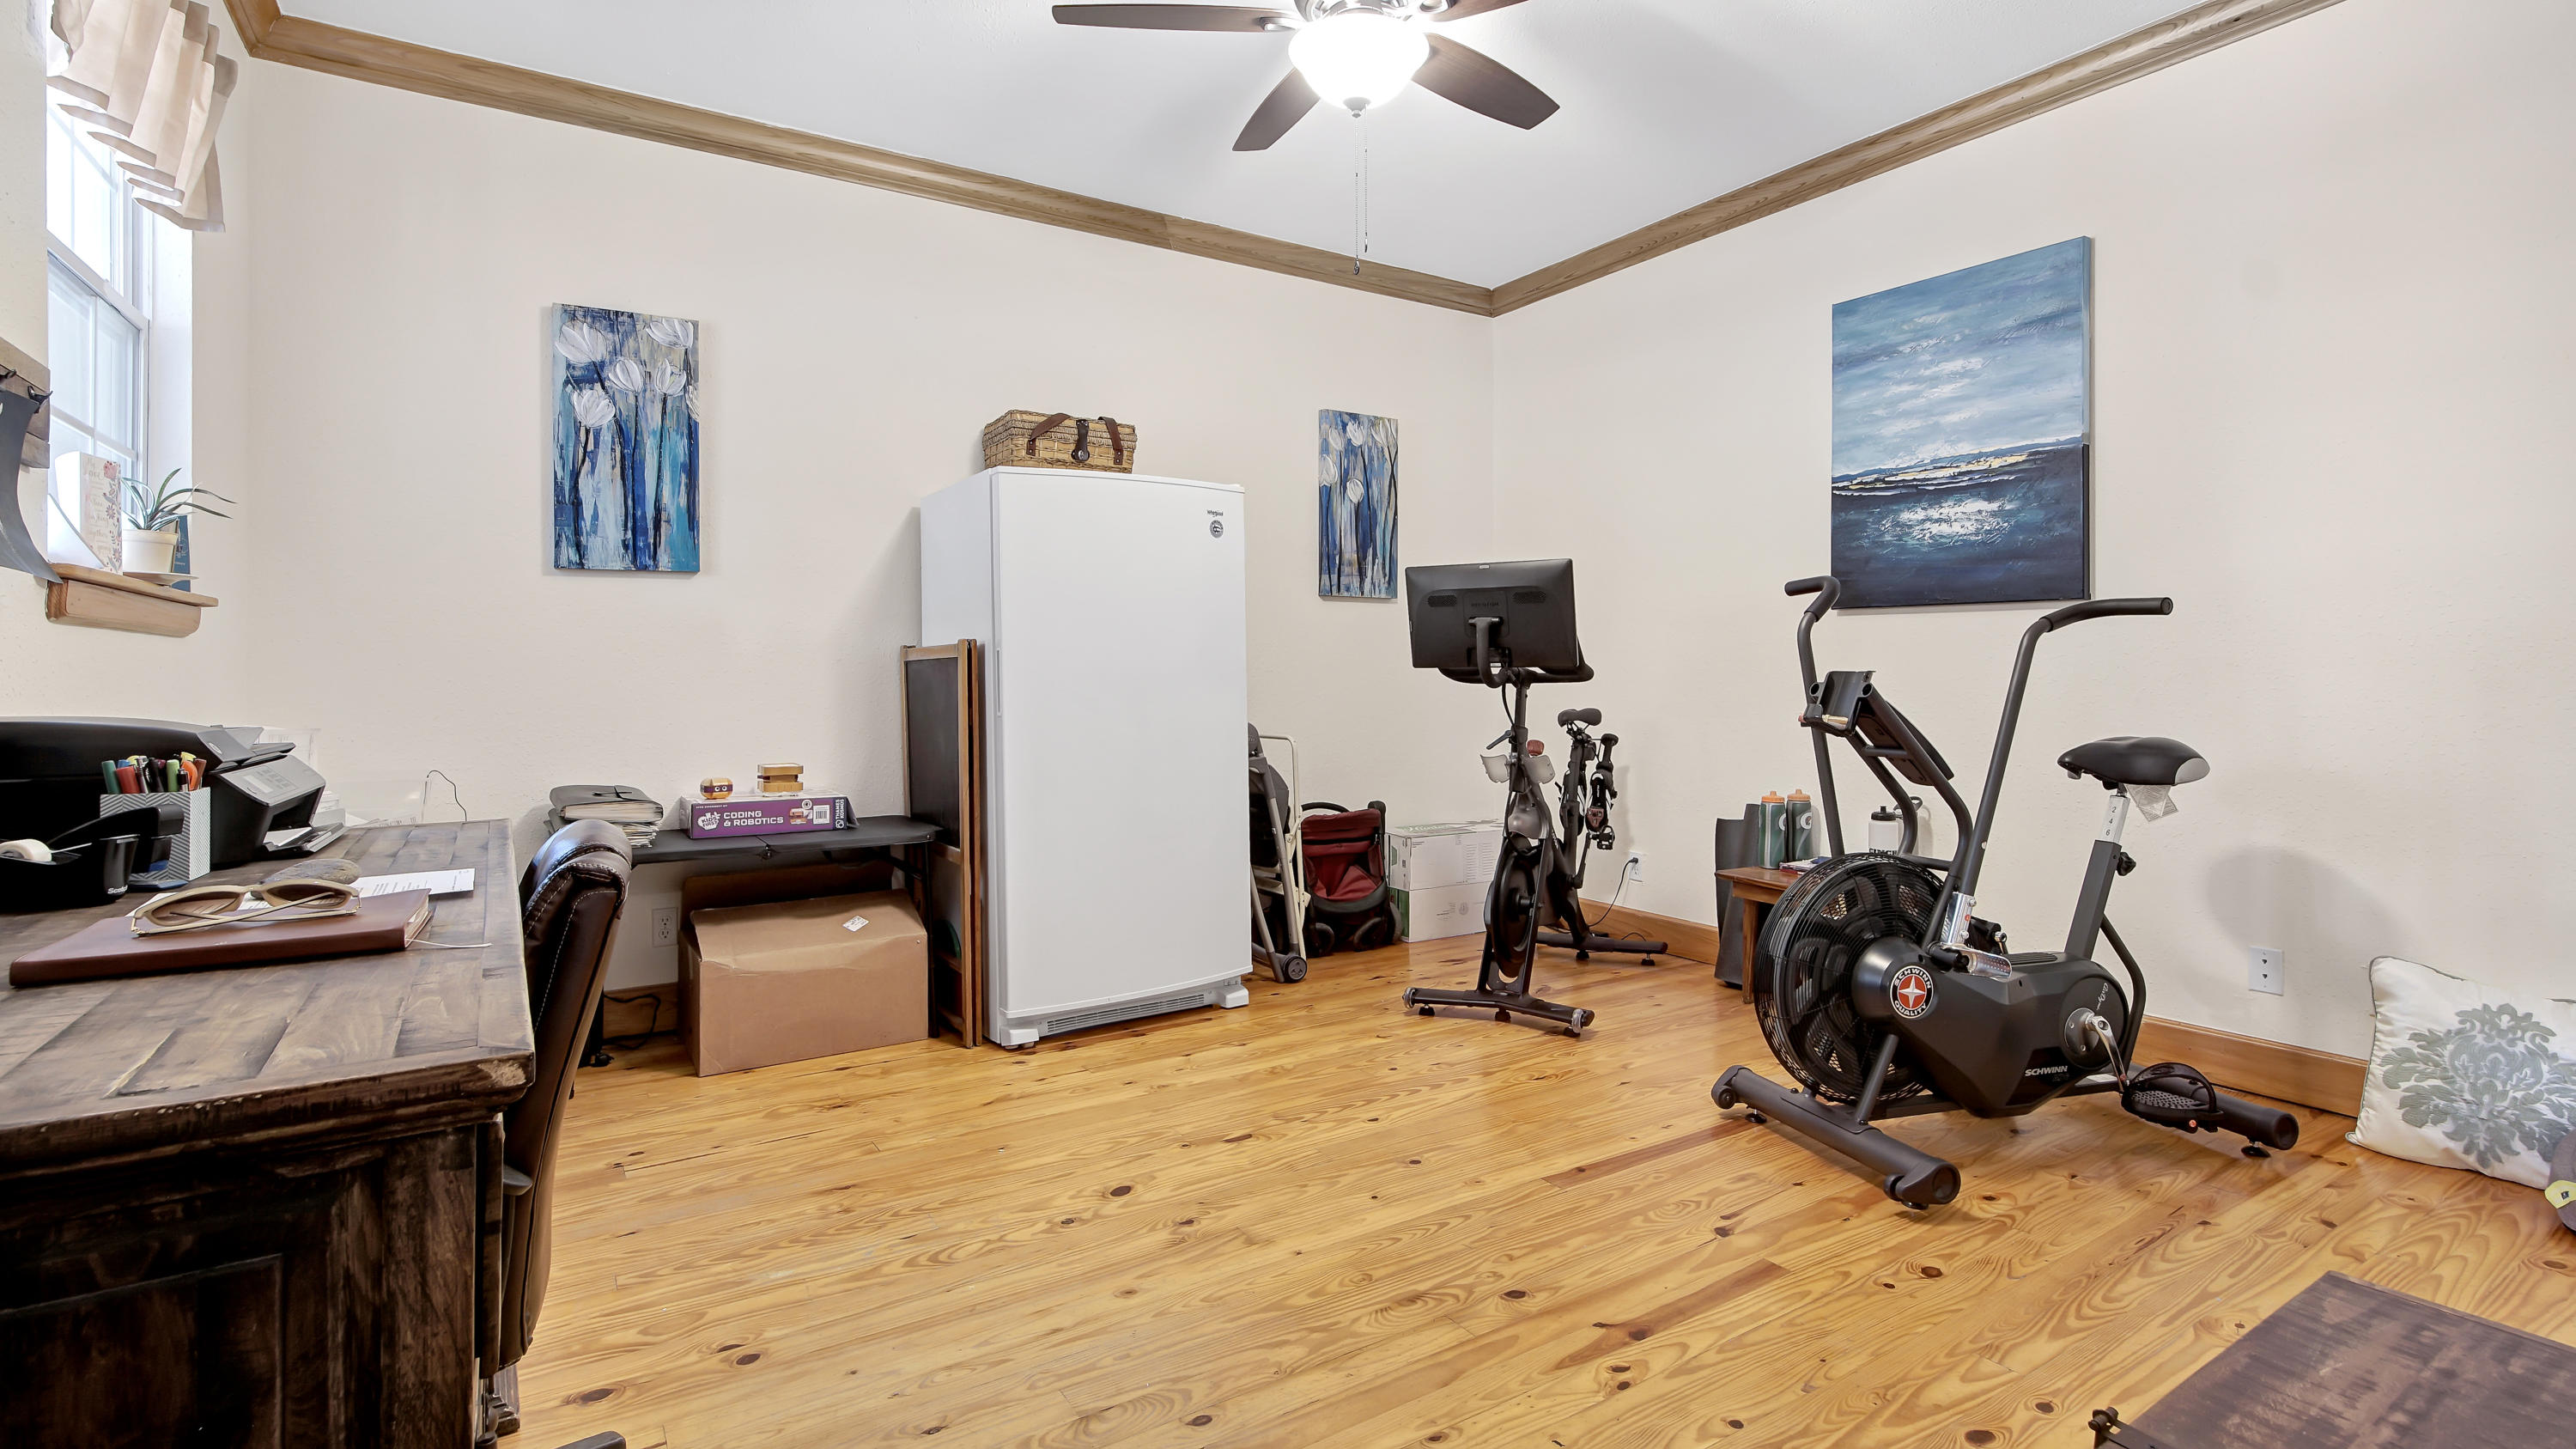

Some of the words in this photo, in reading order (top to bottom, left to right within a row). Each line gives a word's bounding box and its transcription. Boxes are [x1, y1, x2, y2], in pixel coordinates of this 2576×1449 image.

[723, 810, 762, 819] CODING
[733, 817, 784, 826] ROBOTICS
[1894, 968, 1932, 989] SCHWINN
[1894, 1000, 1927, 1016] QUALITY
[2025, 1065, 2069, 1076] SCHWINN
